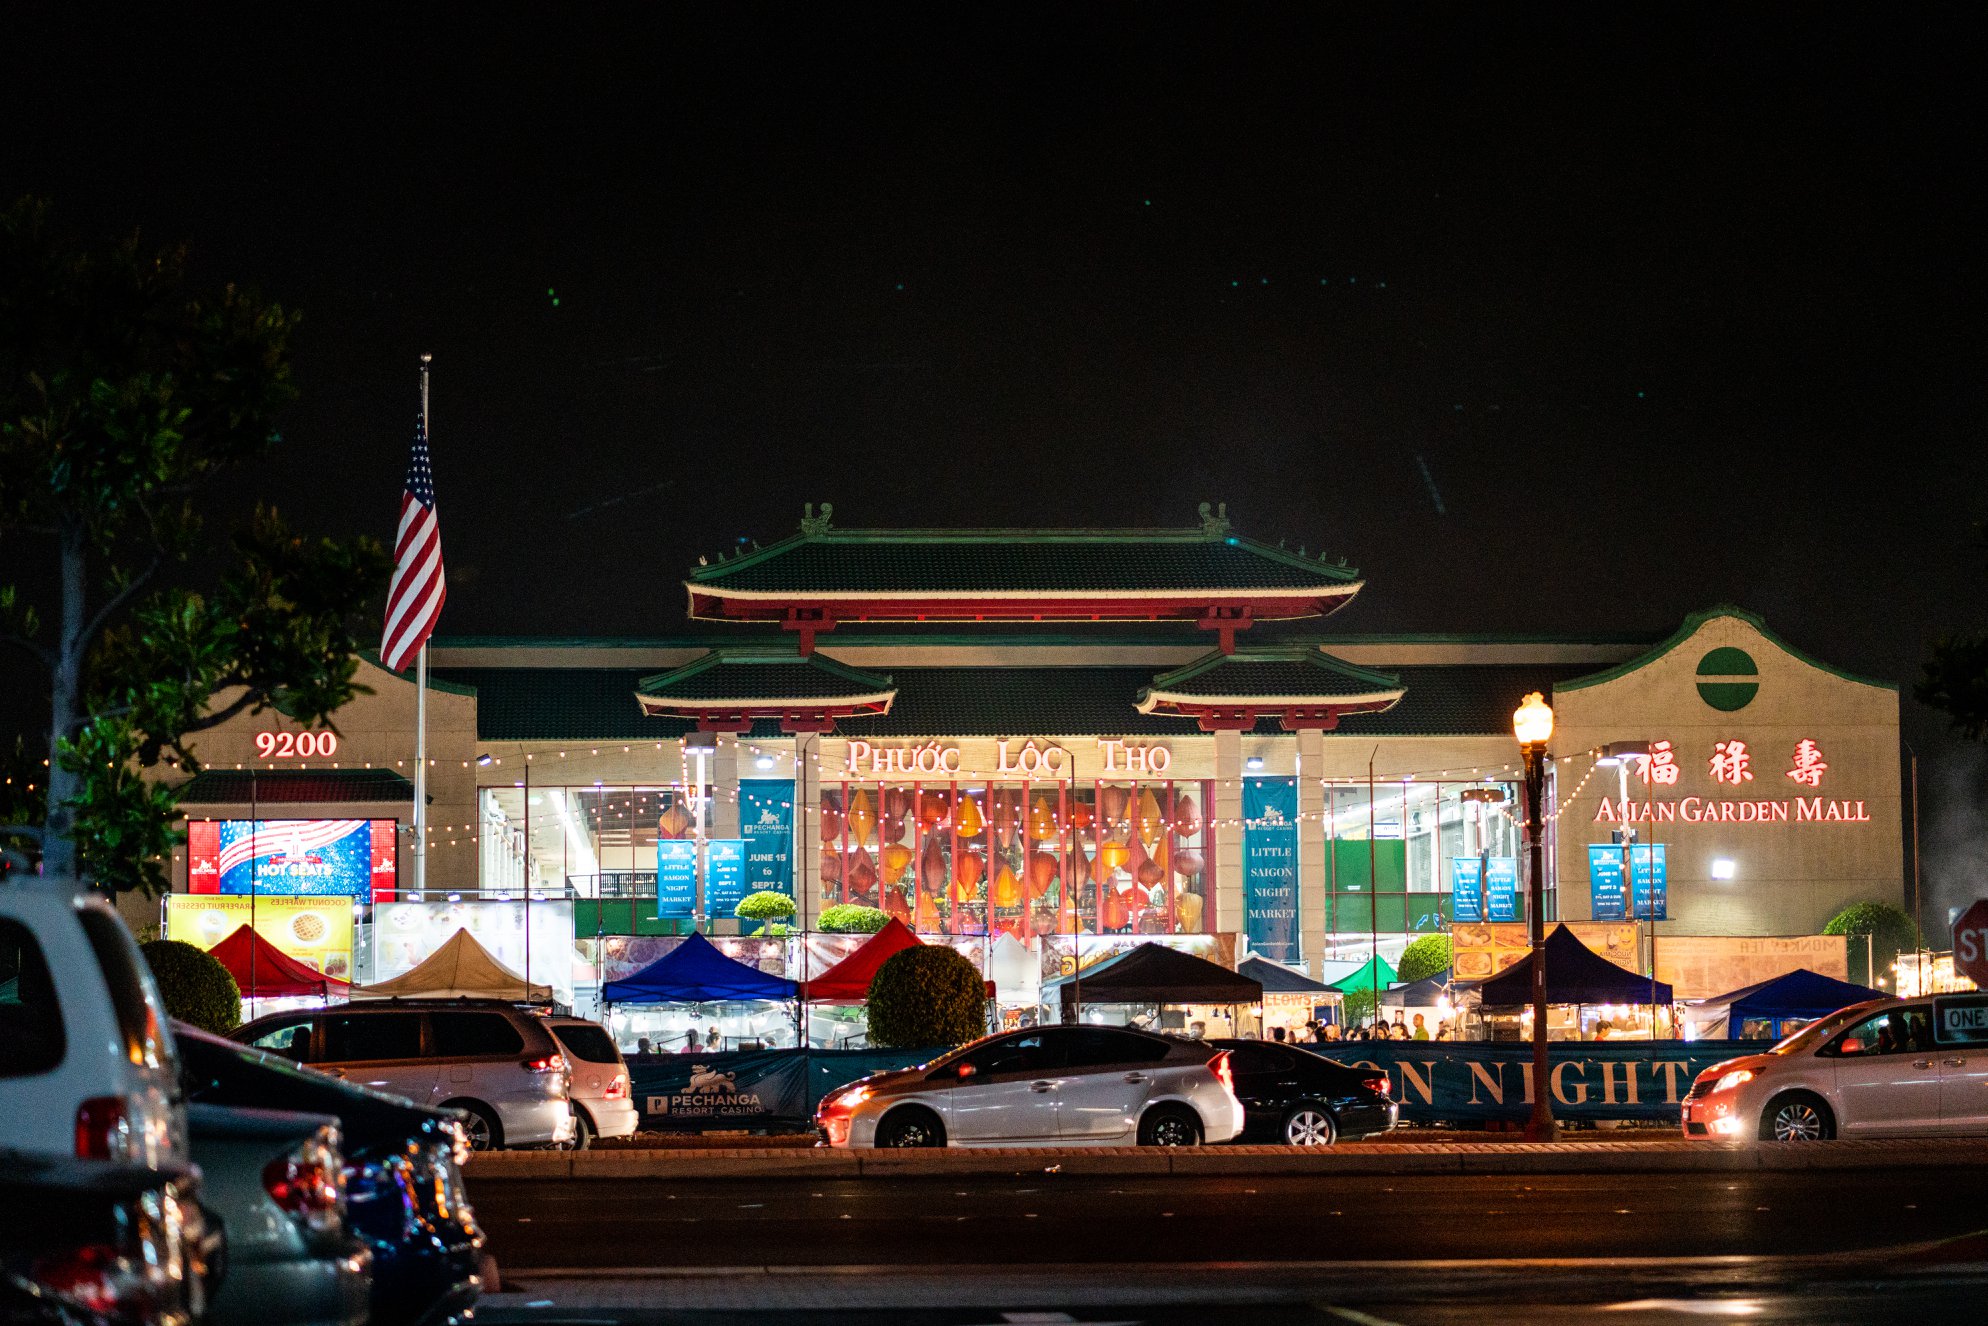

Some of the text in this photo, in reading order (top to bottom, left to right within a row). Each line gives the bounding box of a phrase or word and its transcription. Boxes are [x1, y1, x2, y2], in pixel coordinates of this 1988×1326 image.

[255, 731, 337, 759] 9200
[848, 739, 1171, 777] PHƯỚC LỘC THỌ
[1679, 796, 1788, 822] GARDEN
[1795, 796, 1870, 822] MALL
[776, 853, 786, 861] 15
[1251, 848, 1292, 857] LITTLE
[257, 864, 332, 876] HOT SEATS
[1250, 868, 1292, 877] SAIGON
[752, 881, 783, 889] SEPT 2
[1254, 888, 1290, 897] NIGHT
[1249, 909, 1296, 918] MARKET
[1950, 1009, 1984, 1027] ONE
[1465, 1061, 1690, 1105] NIGHT
[672, 1095, 760, 1106] PECHANGA
[721, 1106, 762, 1114] CASINO
